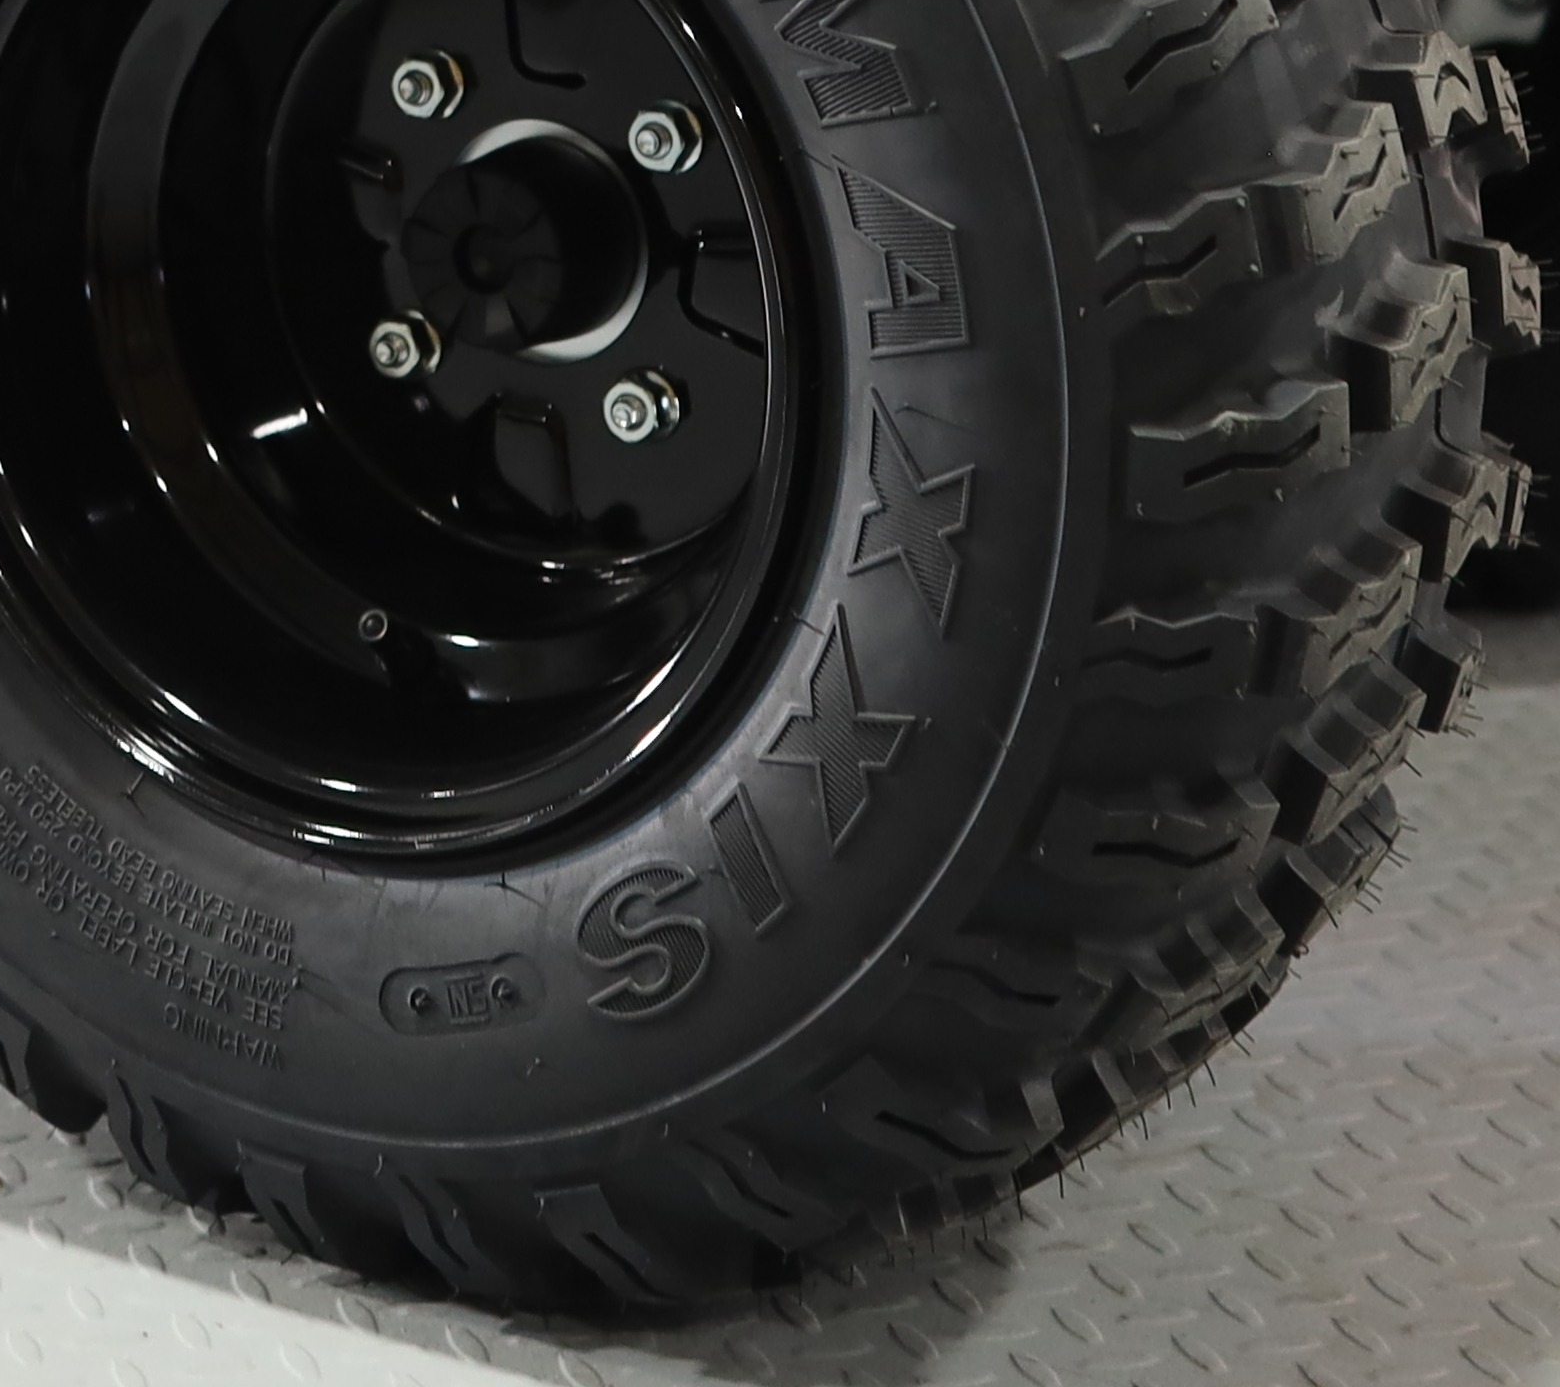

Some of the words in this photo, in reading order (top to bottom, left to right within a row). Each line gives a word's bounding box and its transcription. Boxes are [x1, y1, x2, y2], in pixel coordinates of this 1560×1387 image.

[24, 761, 102, 842] TUBELESS
[30, 799, 67, 839] 250
[67, 832, 137, 898] BEYOND
[111, 835, 157, 882] BEAD
[26, 842, 137, 937] OPERATING
[33, 877, 65, 913] OR
[139, 885, 214, 943] INFLATE
[160, 867, 237, 921] SEATING
[77, 907, 136, 973] LABEL
[144, 924, 190, 965] FOR
[219, 924, 258, 957] NOT
[243, 904, 294, 944] WHEN
[199, 950, 289, 1000] MANUAL
[262, 940, 291, 965] DO
[144, 953, 227, 1016] VEHICLE
[162, 1001, 282, 1072] WARNING
[244, 996, 283, 1029] SEE
